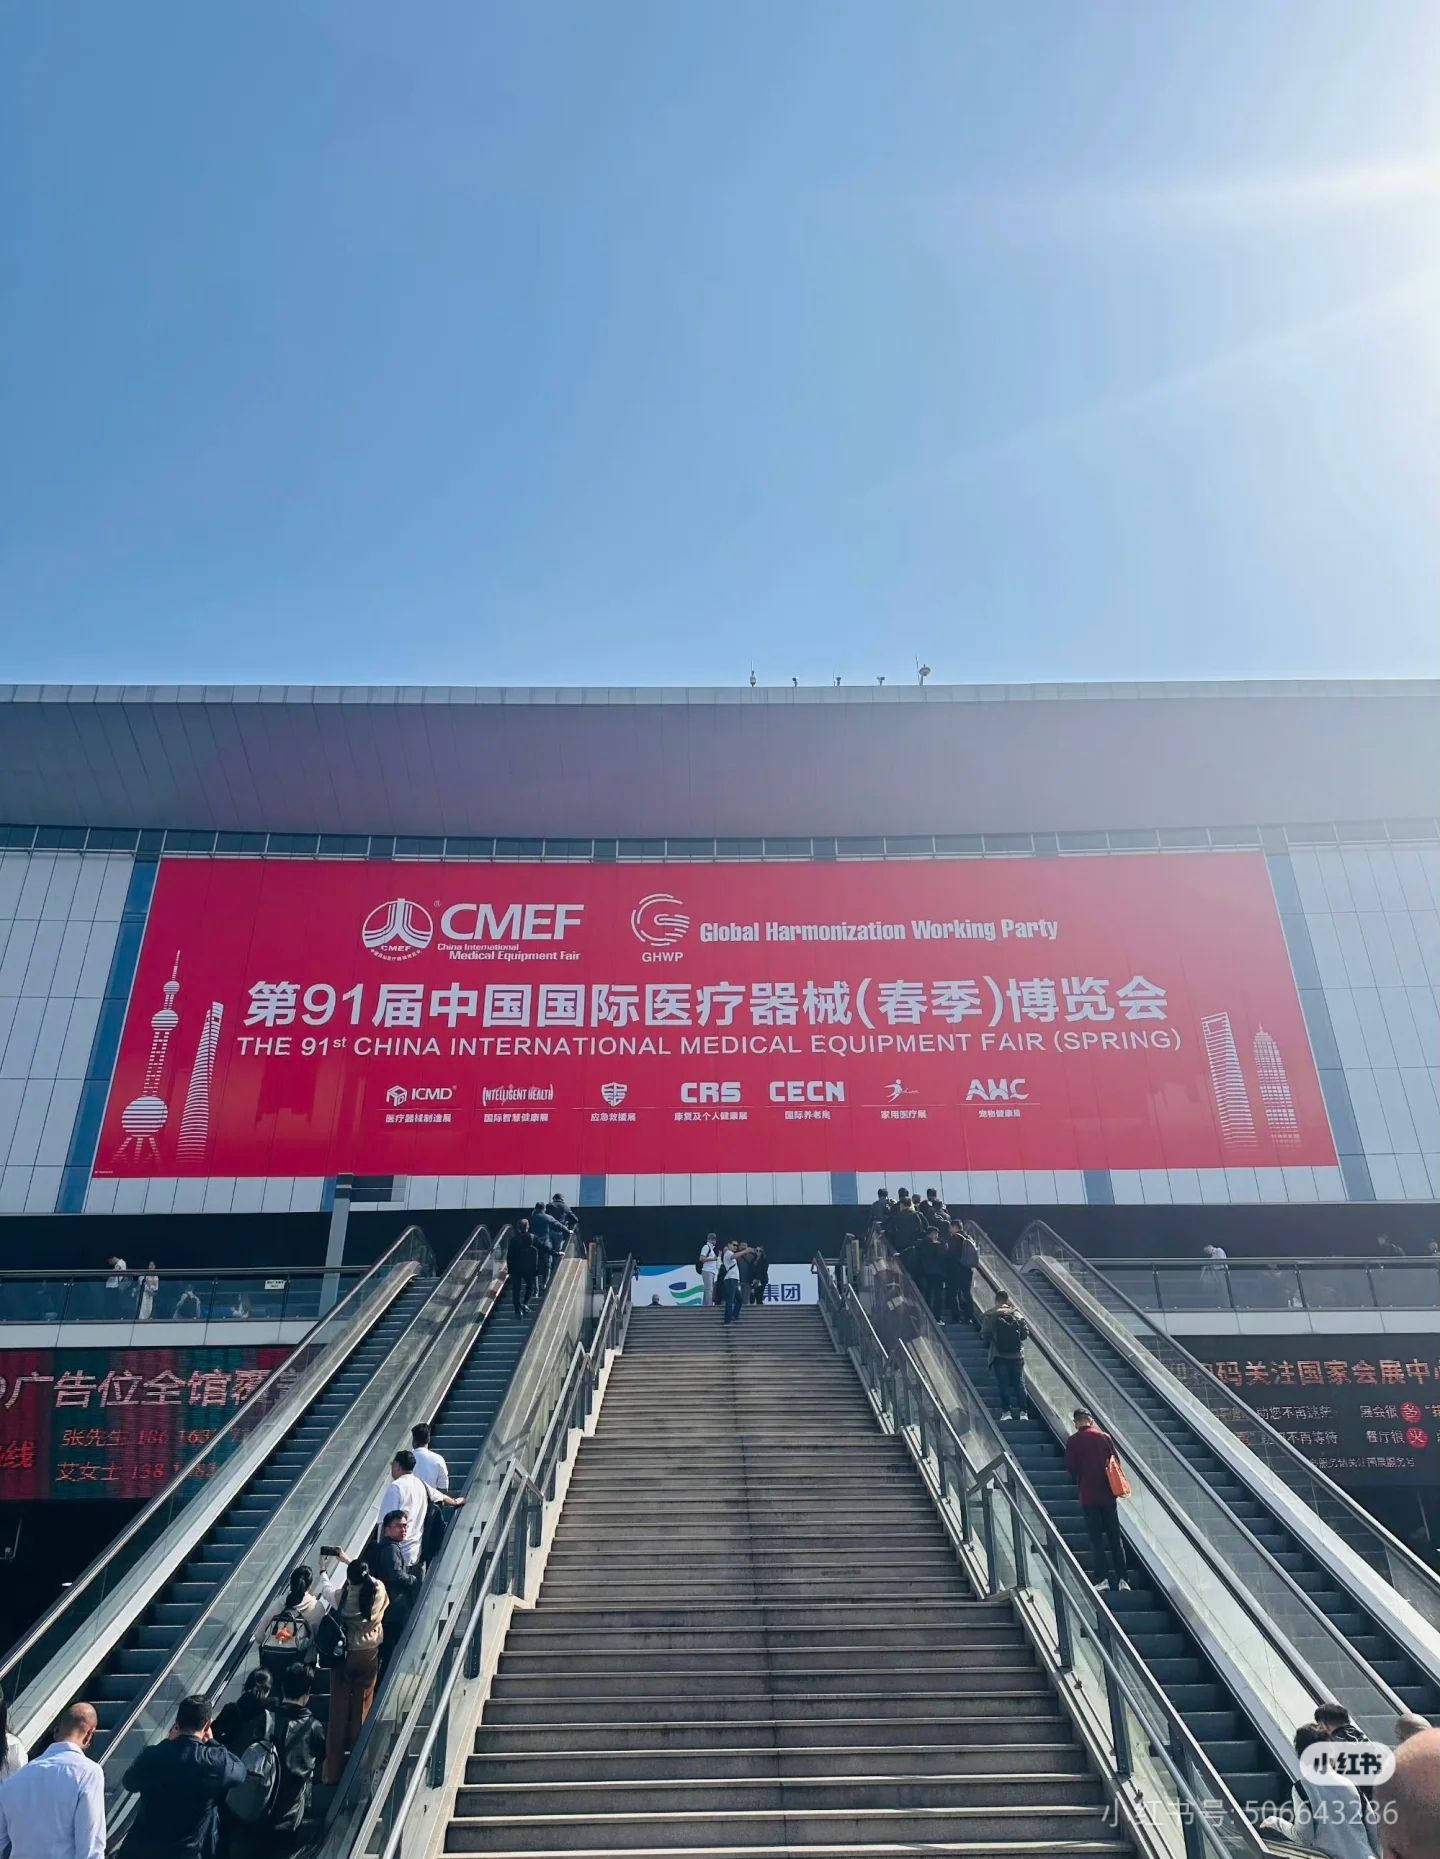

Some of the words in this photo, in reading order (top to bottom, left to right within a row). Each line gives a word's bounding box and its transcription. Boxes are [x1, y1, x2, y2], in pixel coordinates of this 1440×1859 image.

[440, 903, 585, 940] CMEF
[700, 922, 760, 943] Global
[765, 921, 906, 942] Harmonization
[911, 919, 997, 941] Working
[1001, 918, 1059, 940] Party
[437, 943, 463, 951] China
[464, 943, 519, 951] International
[449, 951, 495, 960] Medical
[497, 951, 558, 962] Equipment
[559, 951, 581, 960] Fair
[641, 952, 684, 963] GHWP
[243, 974, 1168, 1029] 第91届中国国际医疗器械(春季)博览会
[237, 1037, 292, 1056] THE
[301, 1036, 347, 1056] 91st
[353, 1036, 441, 1056] CHINA
[450, 1036, 671, 1056] INTERNATIONAL
[680, 1034, 802, 1055] MEDICAL
[811, 1033, 971, 1056] EQUIPMENT
[981, 1031, 1046, 1051] FAIR
[1053, 1028, 1182, 1052] (SPRING)
[411, 1088, 453, 1100] ICMD
[680, 1081, 741, 1103] CRS
[769, 1080, 845, 1102] CECN
[385, 1113, 452, 1123] 医疗器械制造展
[590, 1112, 636, 1122] 应急救援展
[881, 1109, 928, 1119] 家用医疗展
